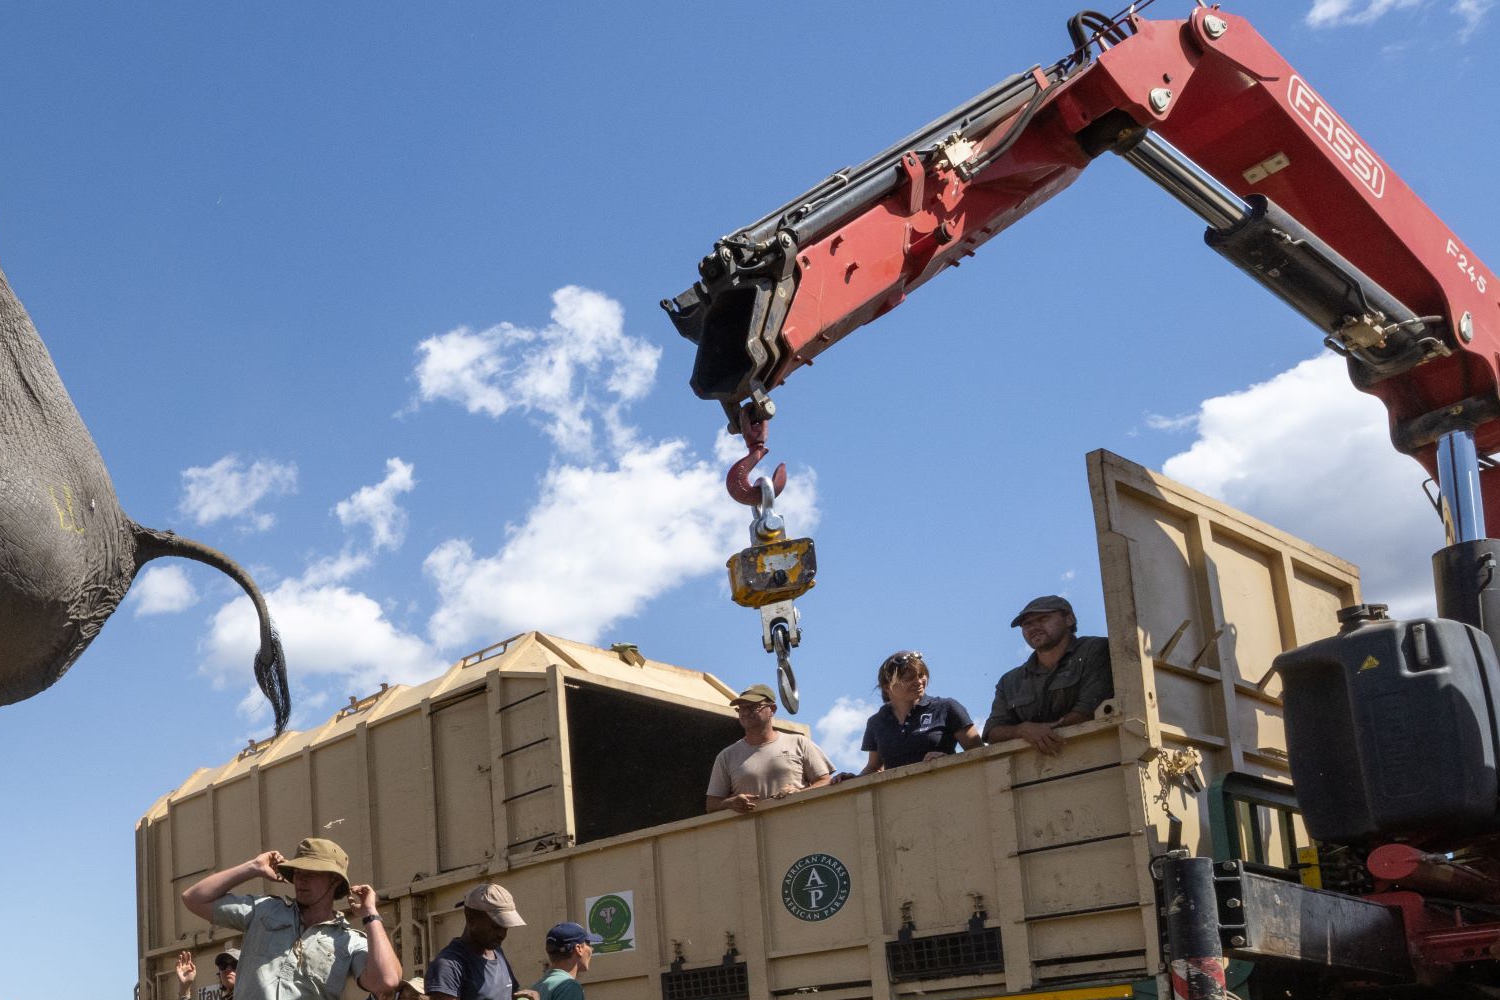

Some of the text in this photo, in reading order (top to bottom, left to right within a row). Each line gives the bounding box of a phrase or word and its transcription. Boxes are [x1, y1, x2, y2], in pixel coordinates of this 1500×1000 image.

[1295, 84, 1378, 189] FASSI
[1446, 238, 1487, 294] F245
[785, 856, 847, 884] AFRICAN PARKS
[784, 889, 847, 920] AFRICAN PARKS
